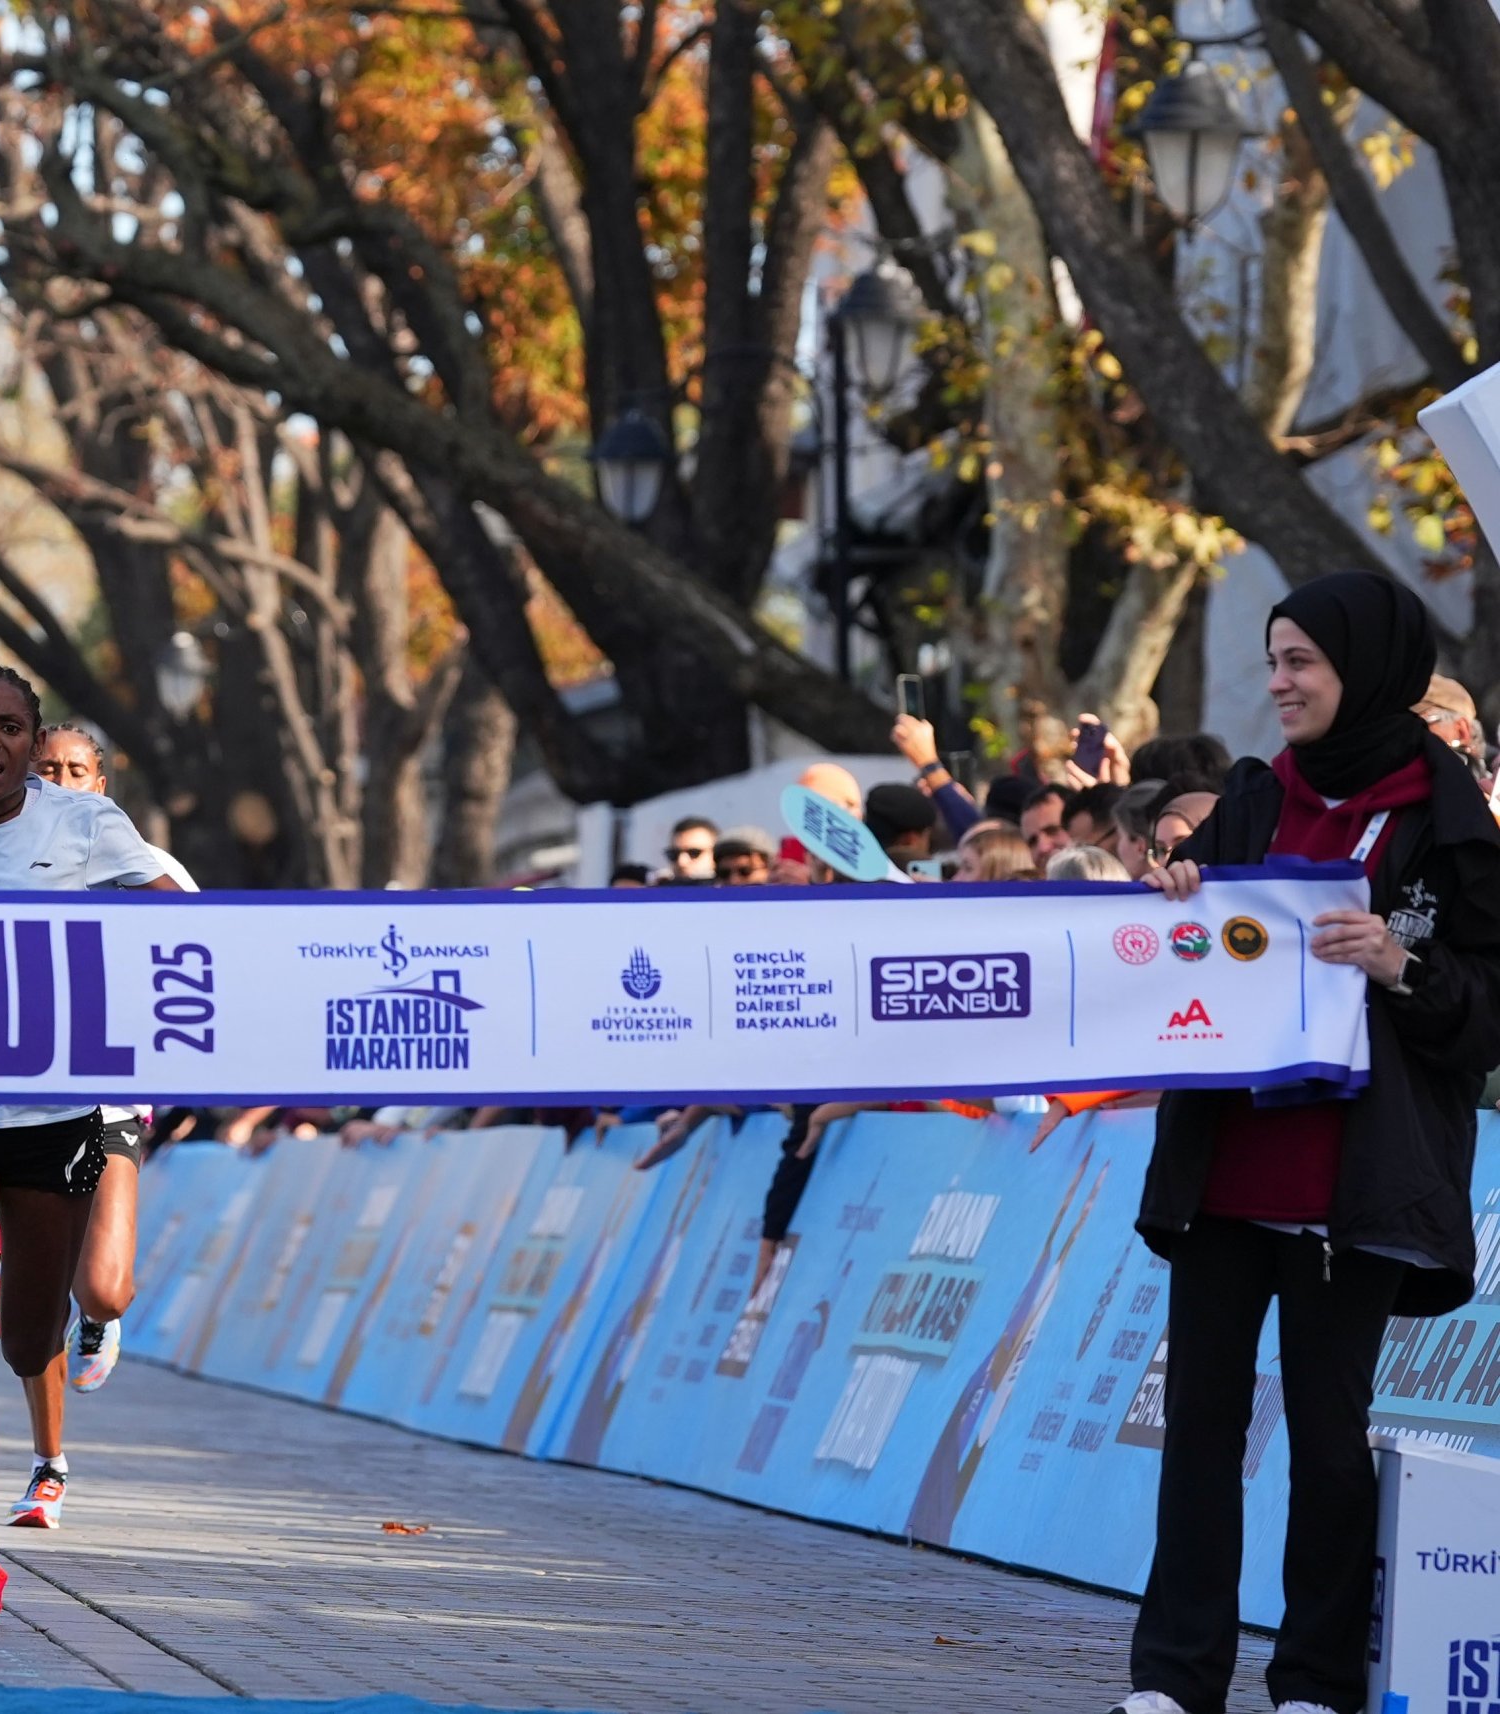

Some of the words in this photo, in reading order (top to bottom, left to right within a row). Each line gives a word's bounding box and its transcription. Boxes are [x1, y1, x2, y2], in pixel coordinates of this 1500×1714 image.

[298, 943, 377, 958] TÜRKİYE
[410, 945, 489, 958] BANKASI
[734, 949, 806, 965] GENÇLİK
[735, 968, 756, 980] VE
[761, 967, 805, 979] SPOR
[880, 958, 1021, 993] SPOR
[736, 980, 833, 996] HİZMETLERİ
[151, 941, 215, 1055] 2025
[736, 997, 801, 1013] DAİRESİ
[591, 1015, 693, 1032] BÜYÜKŞEHİR
[736, 1013, 837, 1031] BAŞKANLIĞI
[325, 1037, 469, 1070] MARATHON
[1416, 1547, 1500, 1575] TÜRKİ
